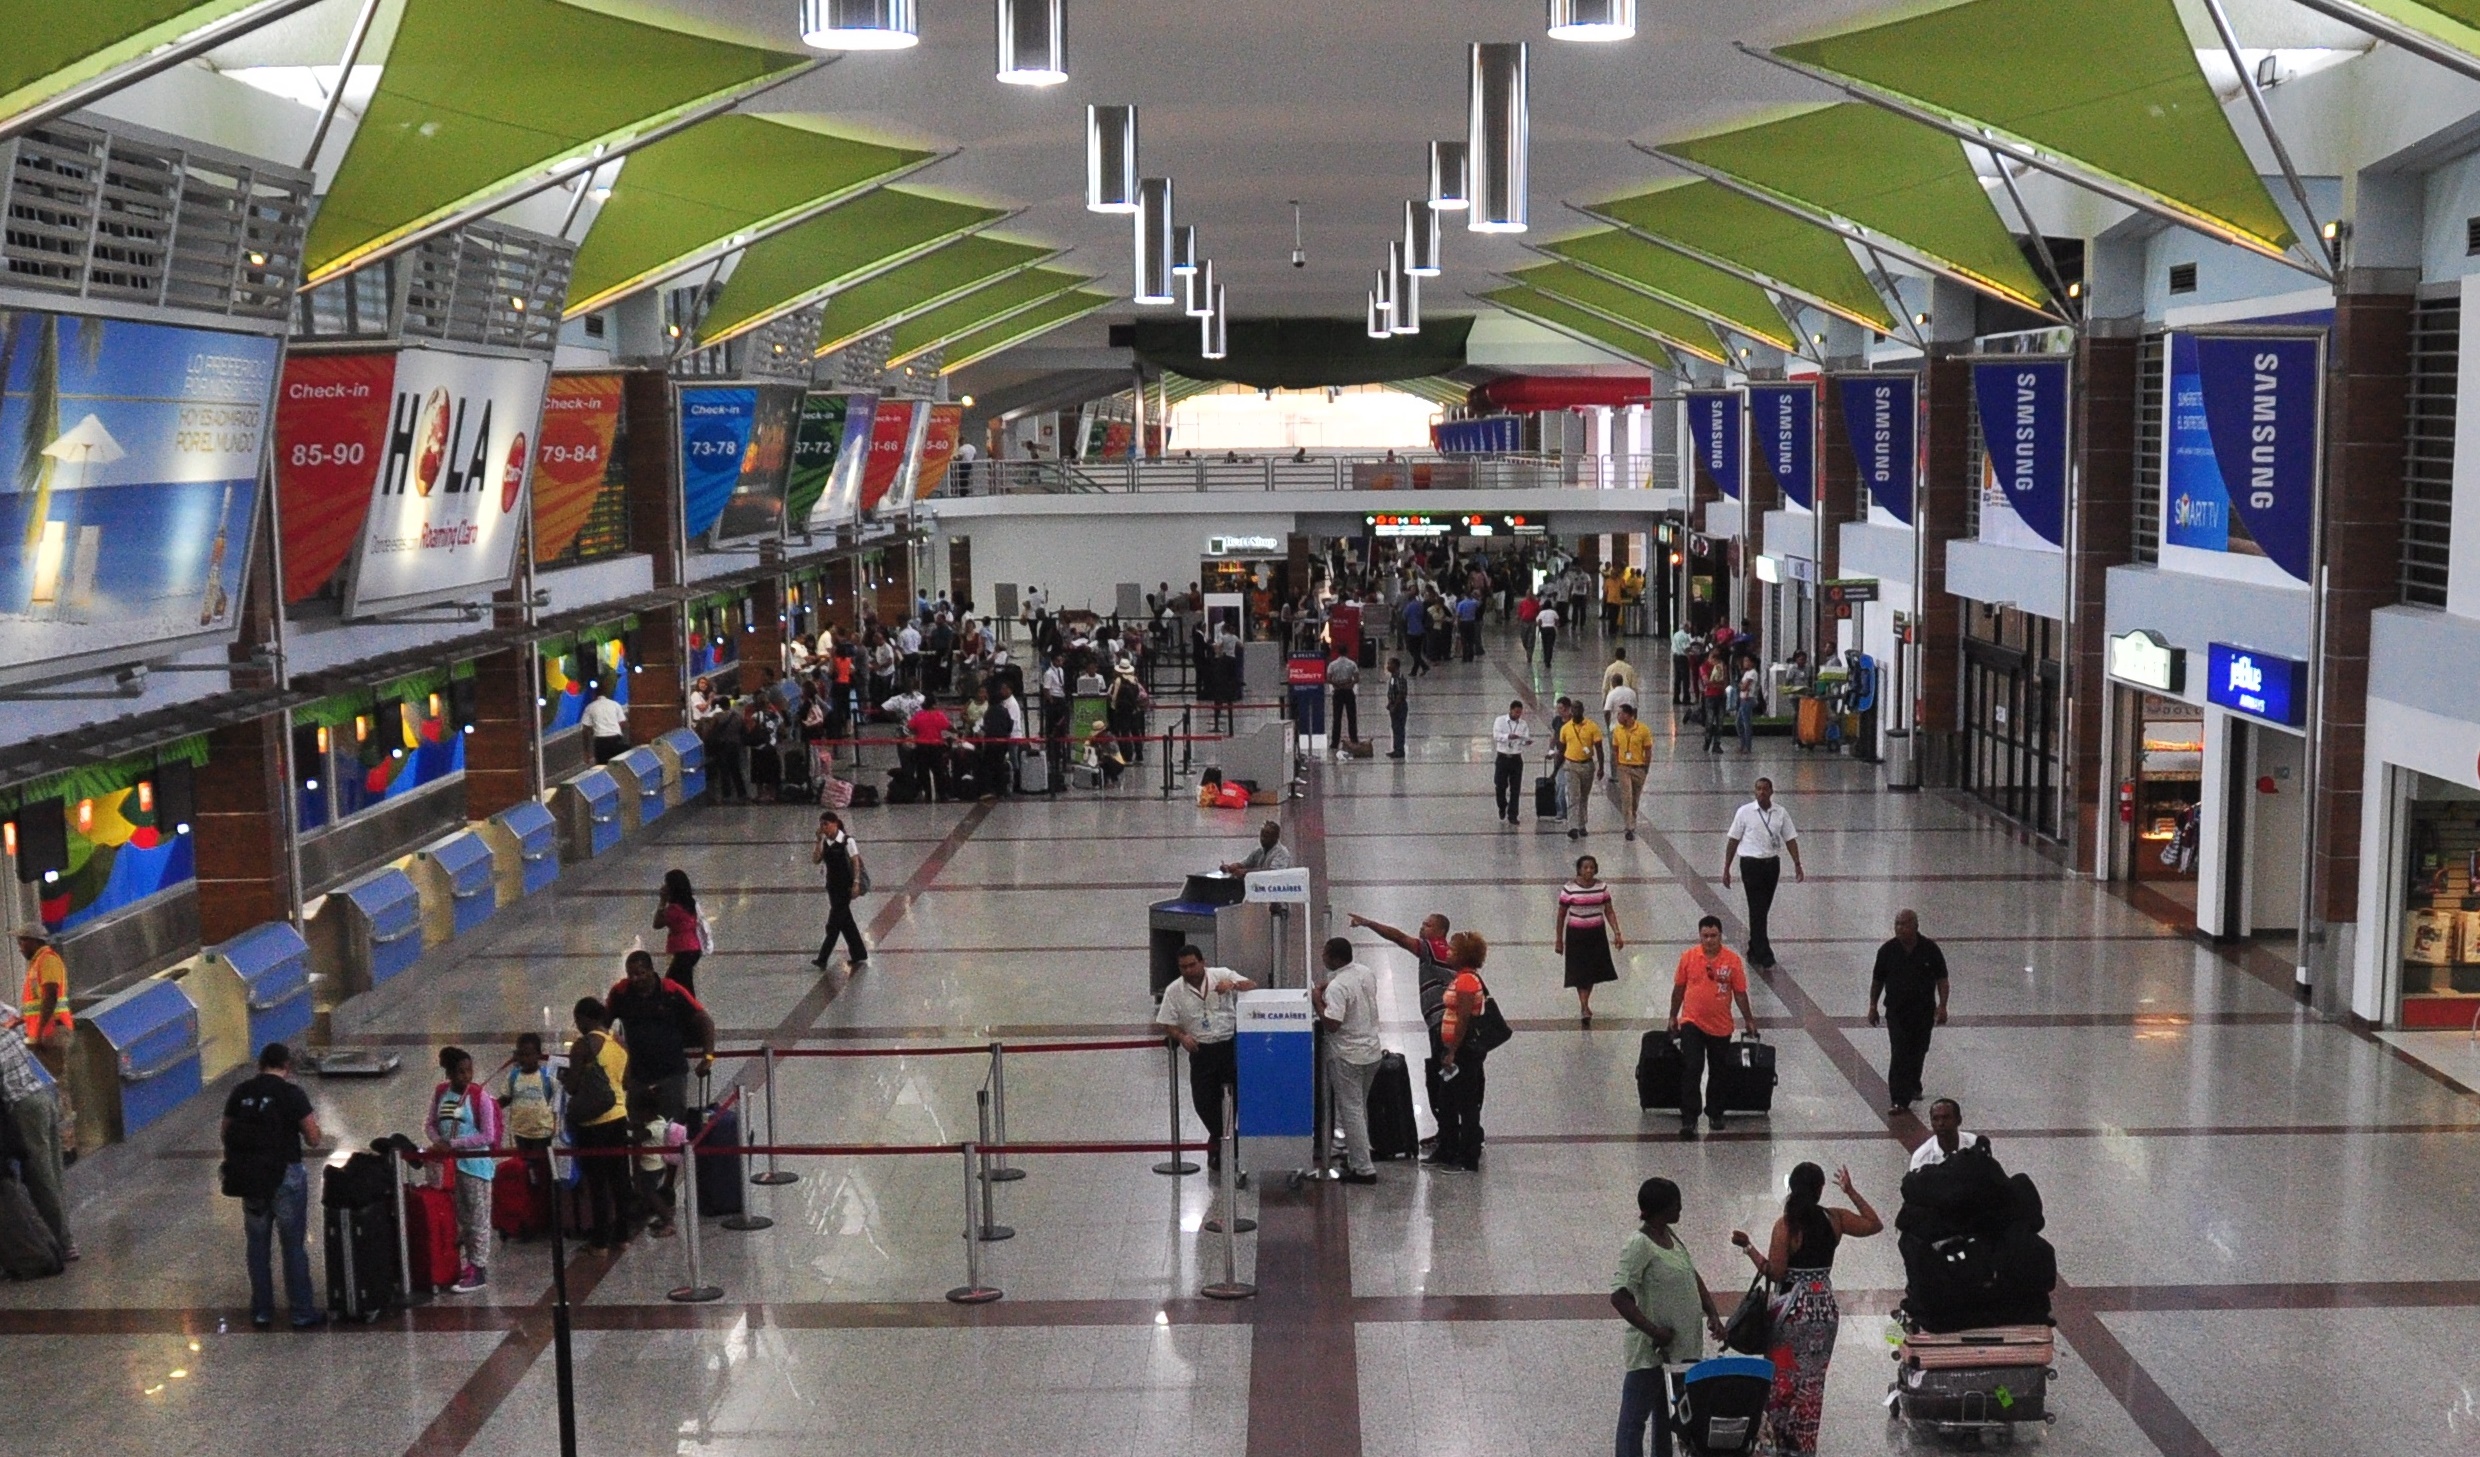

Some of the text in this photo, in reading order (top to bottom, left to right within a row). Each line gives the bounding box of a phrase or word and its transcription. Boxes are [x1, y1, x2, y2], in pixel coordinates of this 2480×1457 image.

[289, 382, 370, 399] Check-in
[690, 405, 740, 415] Check-in
[1711, 400, 1723, 469] SAMSUNG
[1779, 394, 1793, 474] SAMSUNG
[1875, 387, 1890, 481] SAMSUNG
[2016, 373, 2036, 491] SAMSUNG
[2250, 353, 2279, 510] SAMSUNG
[291, 442, 365, 466] 85-90
[543, 445, 598, 463] 79-84
[691, 441, 736, 456] 73-78
[420, 520, 457, 553] Roaming
